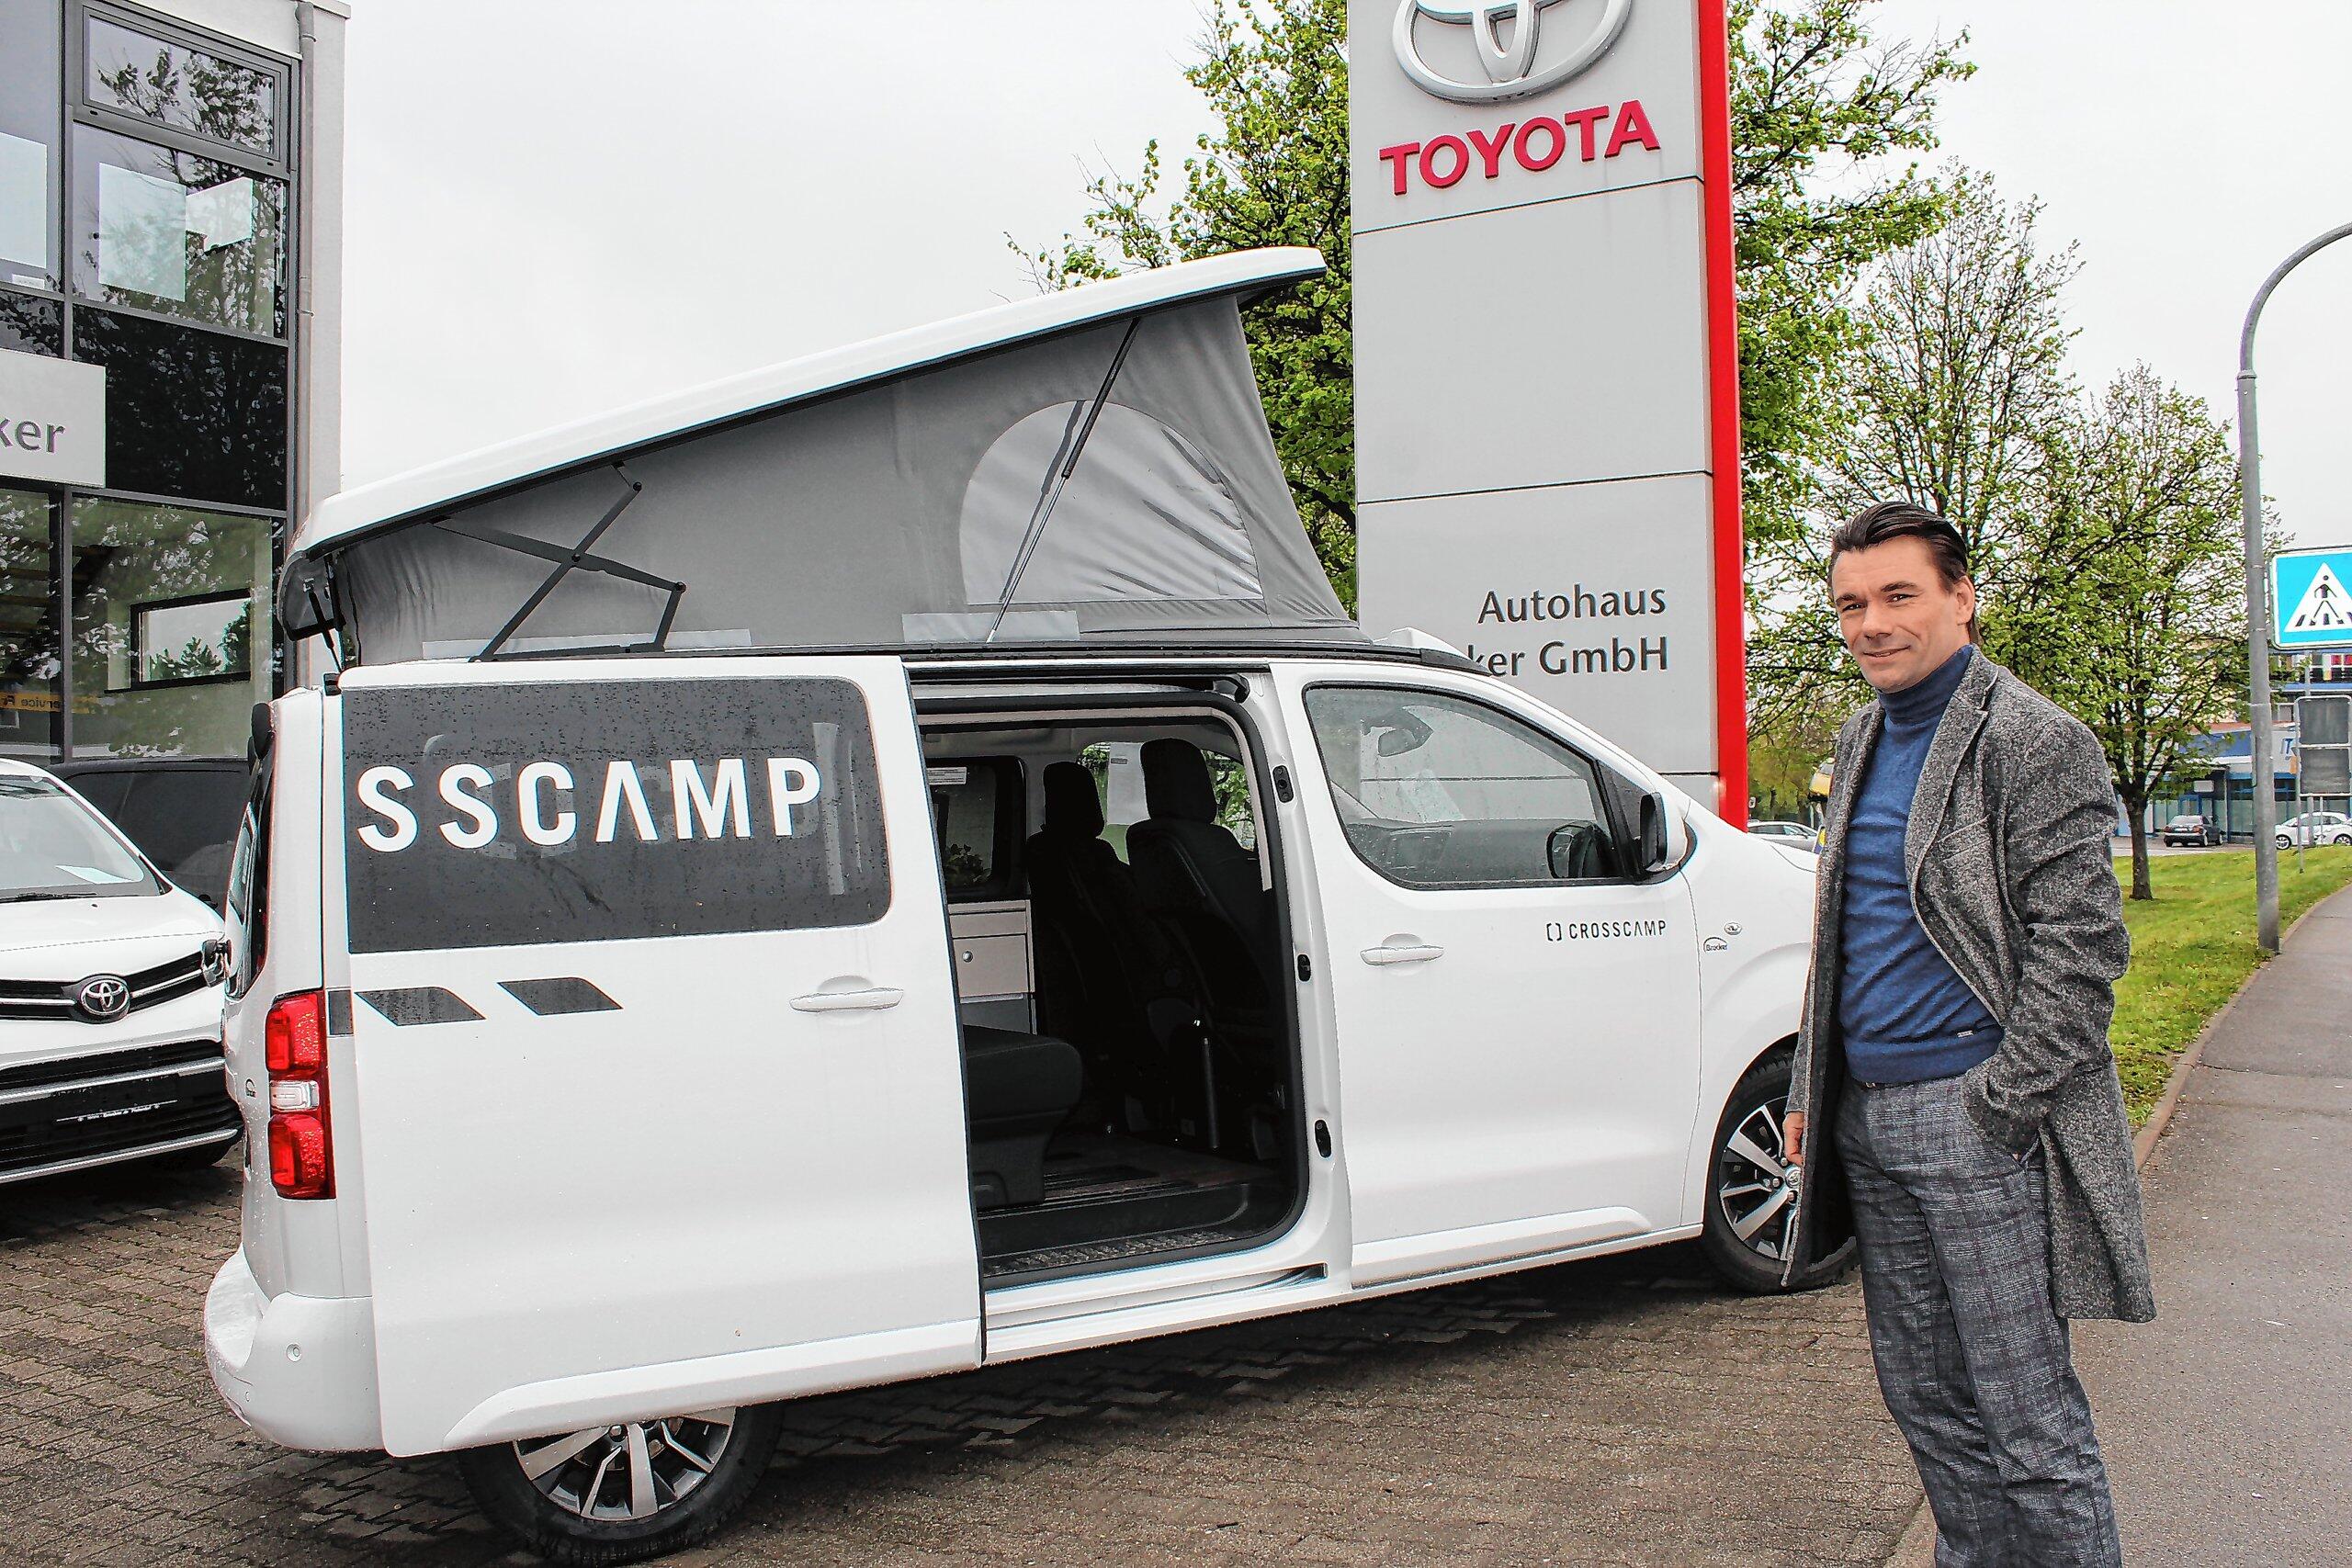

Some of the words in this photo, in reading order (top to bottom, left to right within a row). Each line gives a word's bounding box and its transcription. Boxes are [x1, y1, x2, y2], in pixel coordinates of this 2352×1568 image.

[1379, 99, 1661, 196] TOYOTA
[1476, 582, 1666, 624] Autohaus
[1539, 636, 1668, 675] GmbH
[356, 757, 821, 852] SSCAMP
[1569, 920, 1667, 939] CROSSCAMP
